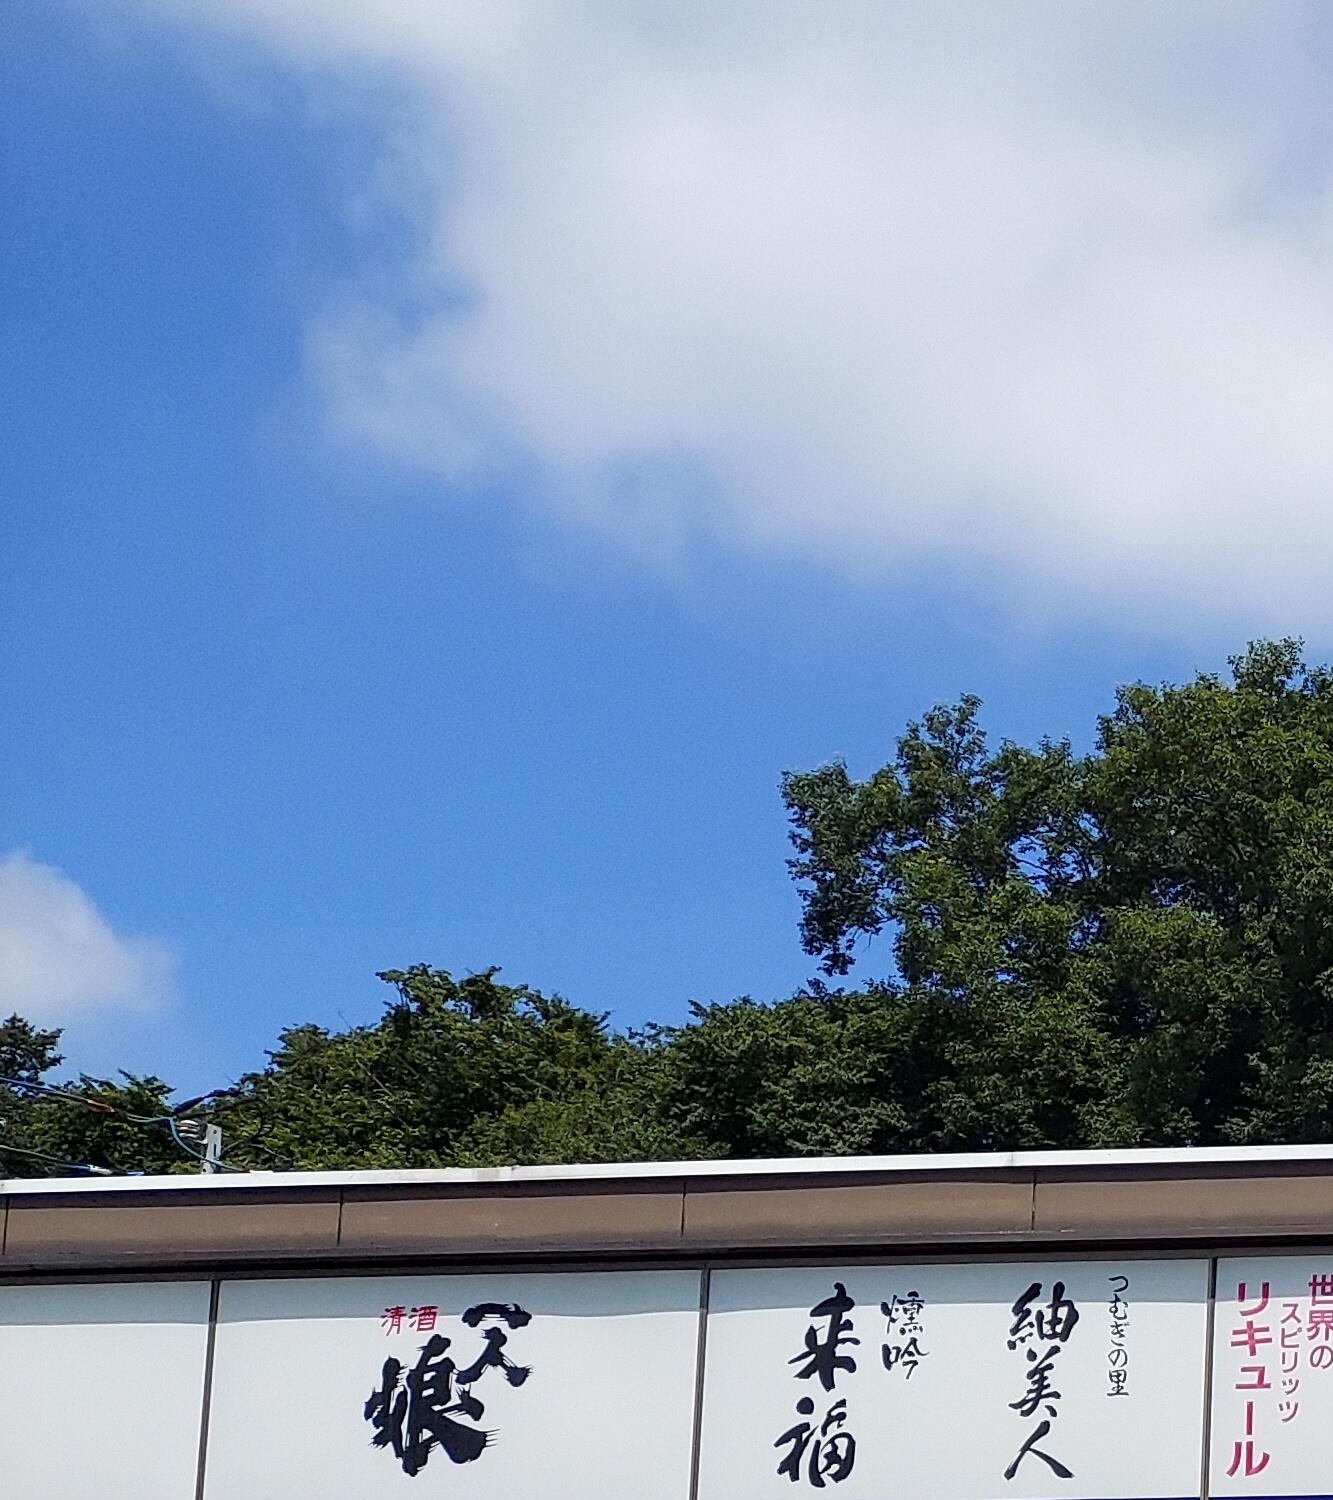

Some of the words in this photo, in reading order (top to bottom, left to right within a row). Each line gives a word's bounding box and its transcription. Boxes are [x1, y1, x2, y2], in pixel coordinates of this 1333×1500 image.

[380, 1304, 438, 1336] 清酒
[773, 1281, 861, 1488] 来福
[1003, 1280, 1080, 1481] 紬美人
[1106, 1275, 1130, 1397] つむぎの里
[1225, 1281, 1273, 1477] リキュール
[1277, 1302, 1306, 1423] スピリッツ
